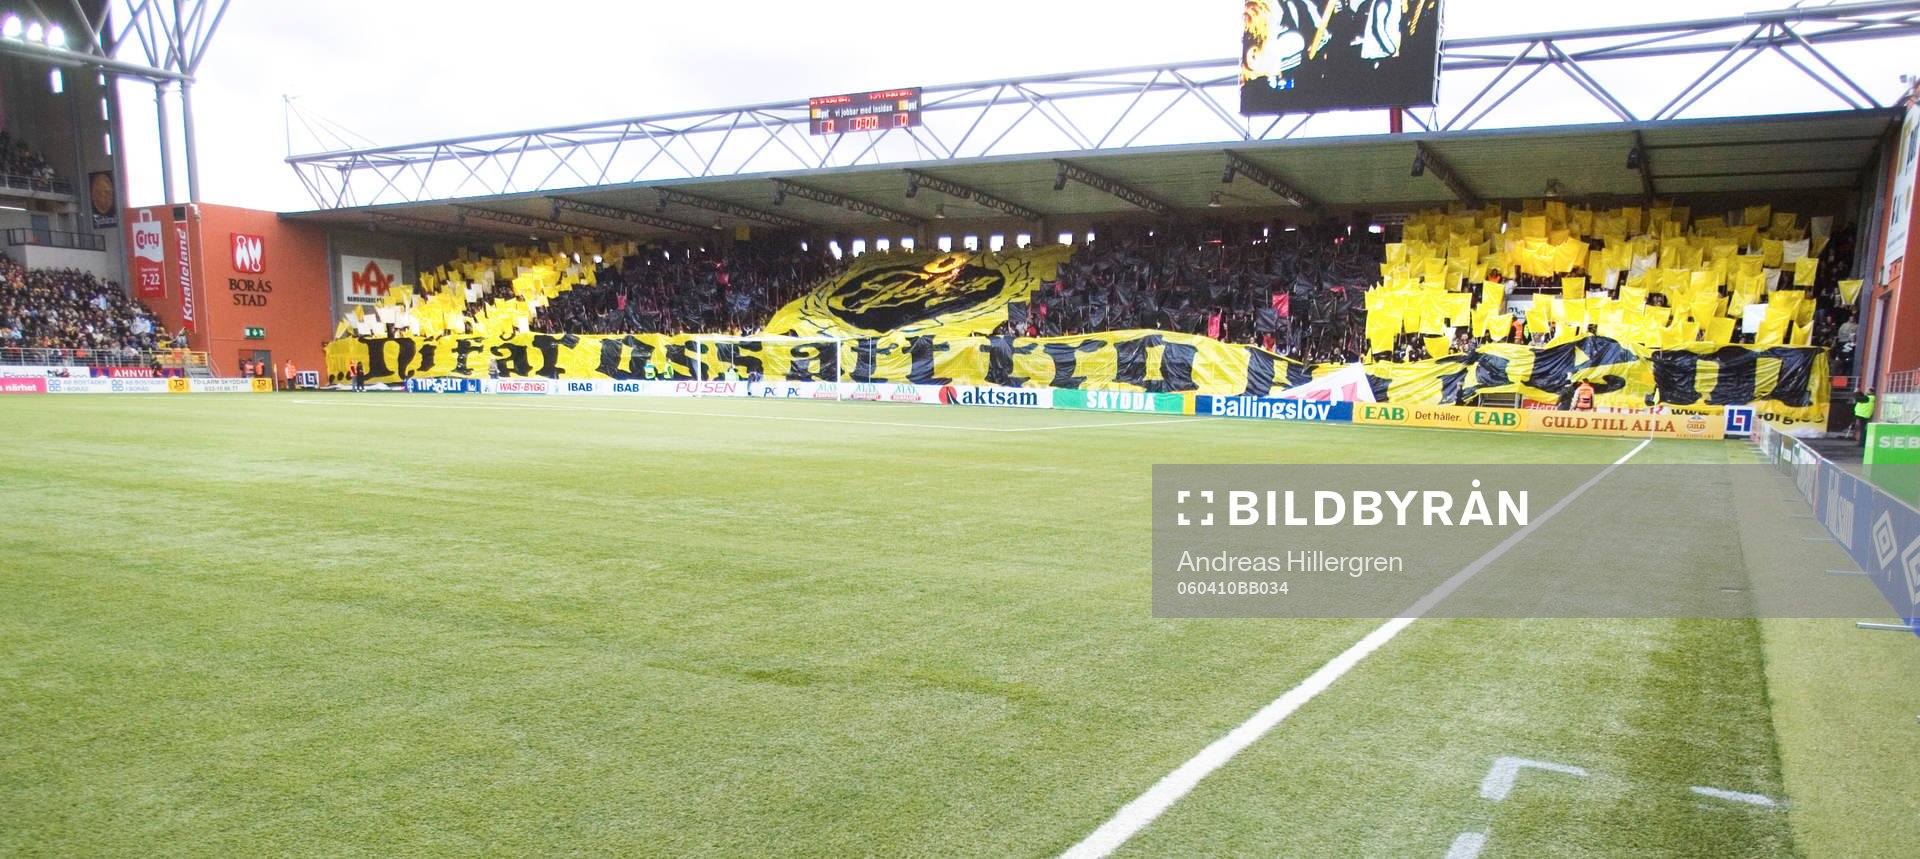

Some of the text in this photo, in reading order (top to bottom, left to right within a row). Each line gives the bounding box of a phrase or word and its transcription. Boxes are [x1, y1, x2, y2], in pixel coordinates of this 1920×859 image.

[177, 228, 193, 321] Knalleland
[352, 260, 394, 296] MAX
[228, 277, 273, 293] BORÅS
[233, 294, 267, 307] STAD
[568, 382, 593, 392] IBAB
[613, 383, 640, 393] IBAB
[675, 382, 736, 393] PUSEN
[962, 387, 1039, 406] aktsam
[1086, 391, 1156, 411] SKYDDA
[1364, 406, 1405, 421] EAB
[1415, 411, 1431, 420] Det
[1474, 411, 1517, 426] EAB
[1542, 415, 1676, 433] GULD TILL ALLA
[1879, 436, 1920, 449] SEB
